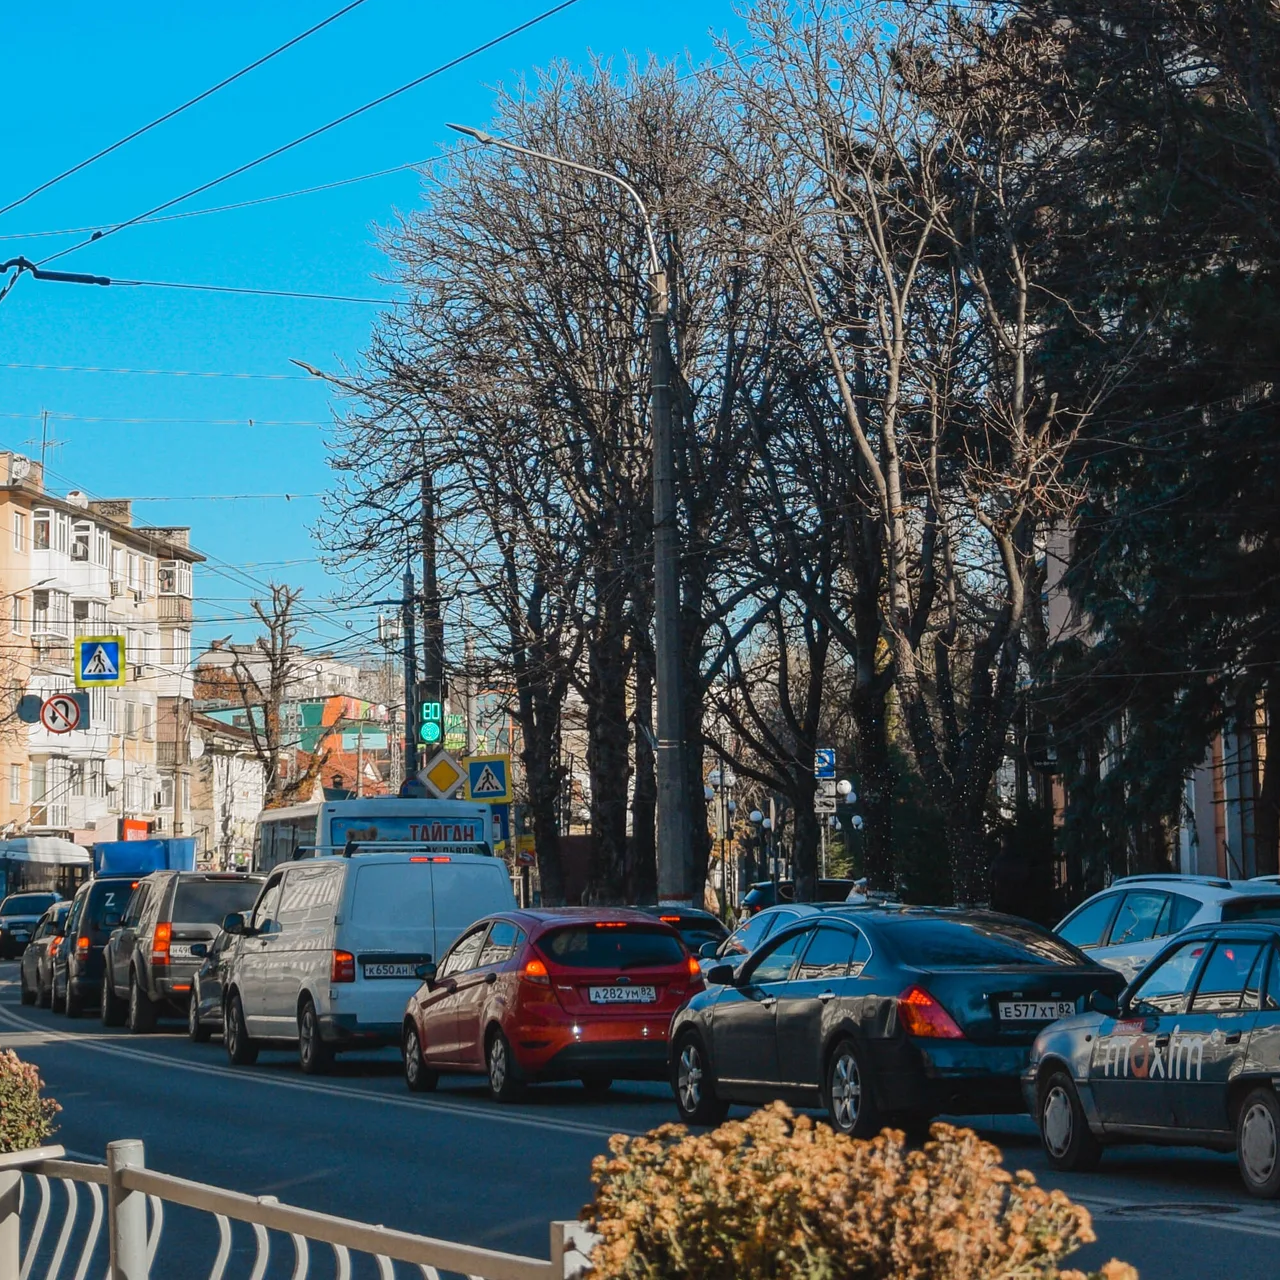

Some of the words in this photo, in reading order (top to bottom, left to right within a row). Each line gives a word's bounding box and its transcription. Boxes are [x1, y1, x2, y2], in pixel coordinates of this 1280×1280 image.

[423, 702, 441, 720] 80
[409, 821, 475, 841] ТАЙГАН
[105, 893, 115, 906] Z
[1104, 1024, 1204, 1081] maxim
